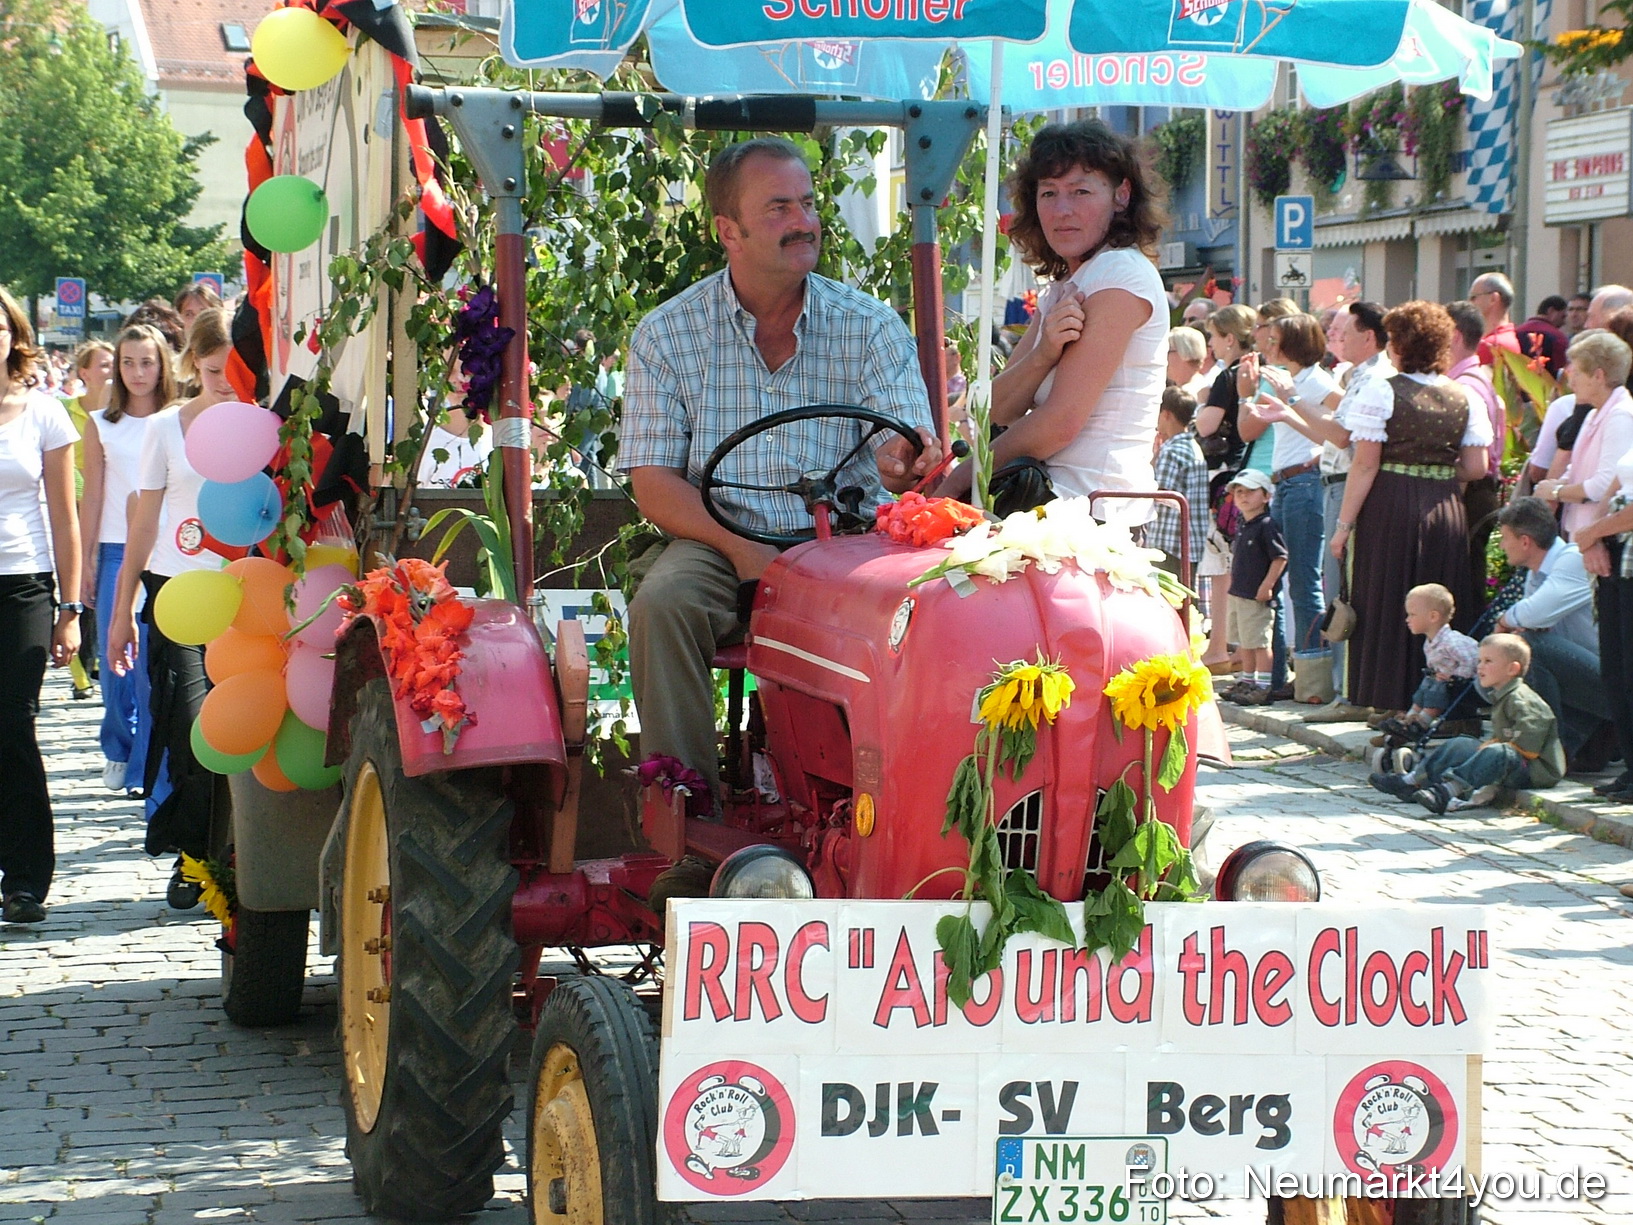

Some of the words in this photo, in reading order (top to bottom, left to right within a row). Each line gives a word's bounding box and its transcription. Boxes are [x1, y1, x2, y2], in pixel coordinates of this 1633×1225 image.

[1283, 202, 1305, 244] P
[58, 304, 82, 316] TAXI
[683, 920, 831, 1024] RRC
[1178, 924, 1296, 1027] the
[1307, 925, 1490, 1028] Clock"
[710, 1102, 734, 1117] Club
[998, 1079, 1080, 1137] SV
[1146, 1080, 1292, 1151] Berg
[1376, 1101, 1400, 1115] Club
[1034, 1142, 1086, 1181] NM
[1140, 1206, 1160, 1222] 10
